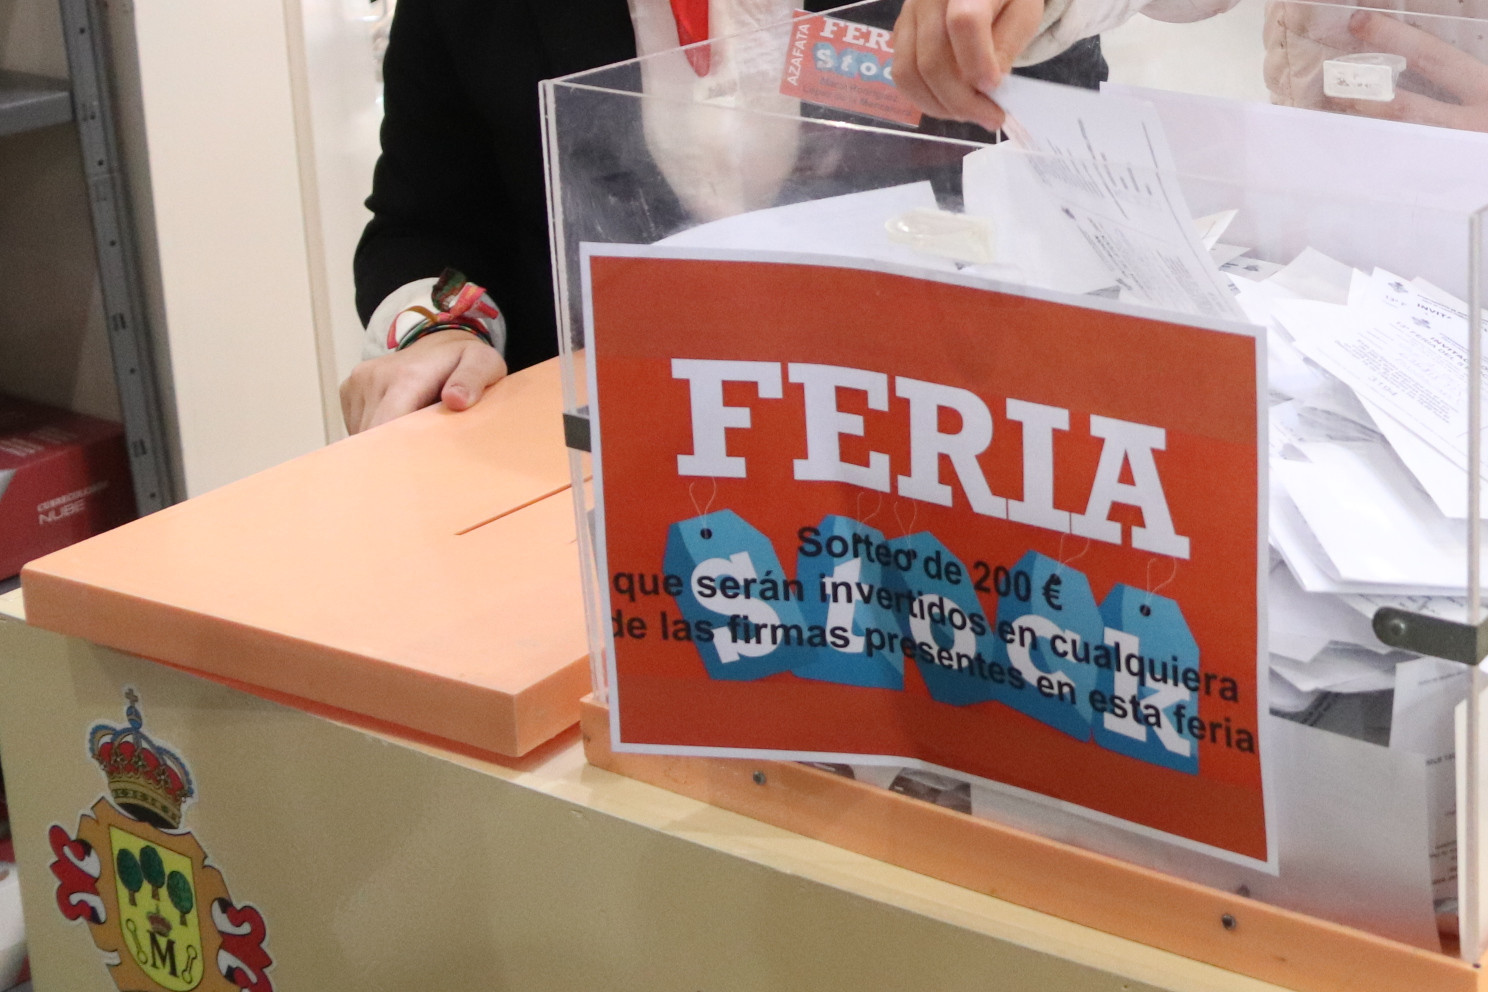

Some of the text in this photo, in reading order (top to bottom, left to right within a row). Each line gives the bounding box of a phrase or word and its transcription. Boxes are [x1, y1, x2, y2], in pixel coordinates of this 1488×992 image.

[786, 24, 811, 86] AZAFATA
[820, 16, 895, 53] FER
[670, 357, 1191, 560] FERIA
[38, 498, 86, 525] NUBE
[797, 525, 1063, 611] Sorteo de 200 €
[613, 569, 1240, 704] que serán invertidos en cualquiera
[611, 609, 1257, 755] de las firmas presentes en esta feria
[147, 929, 180, 978] M
